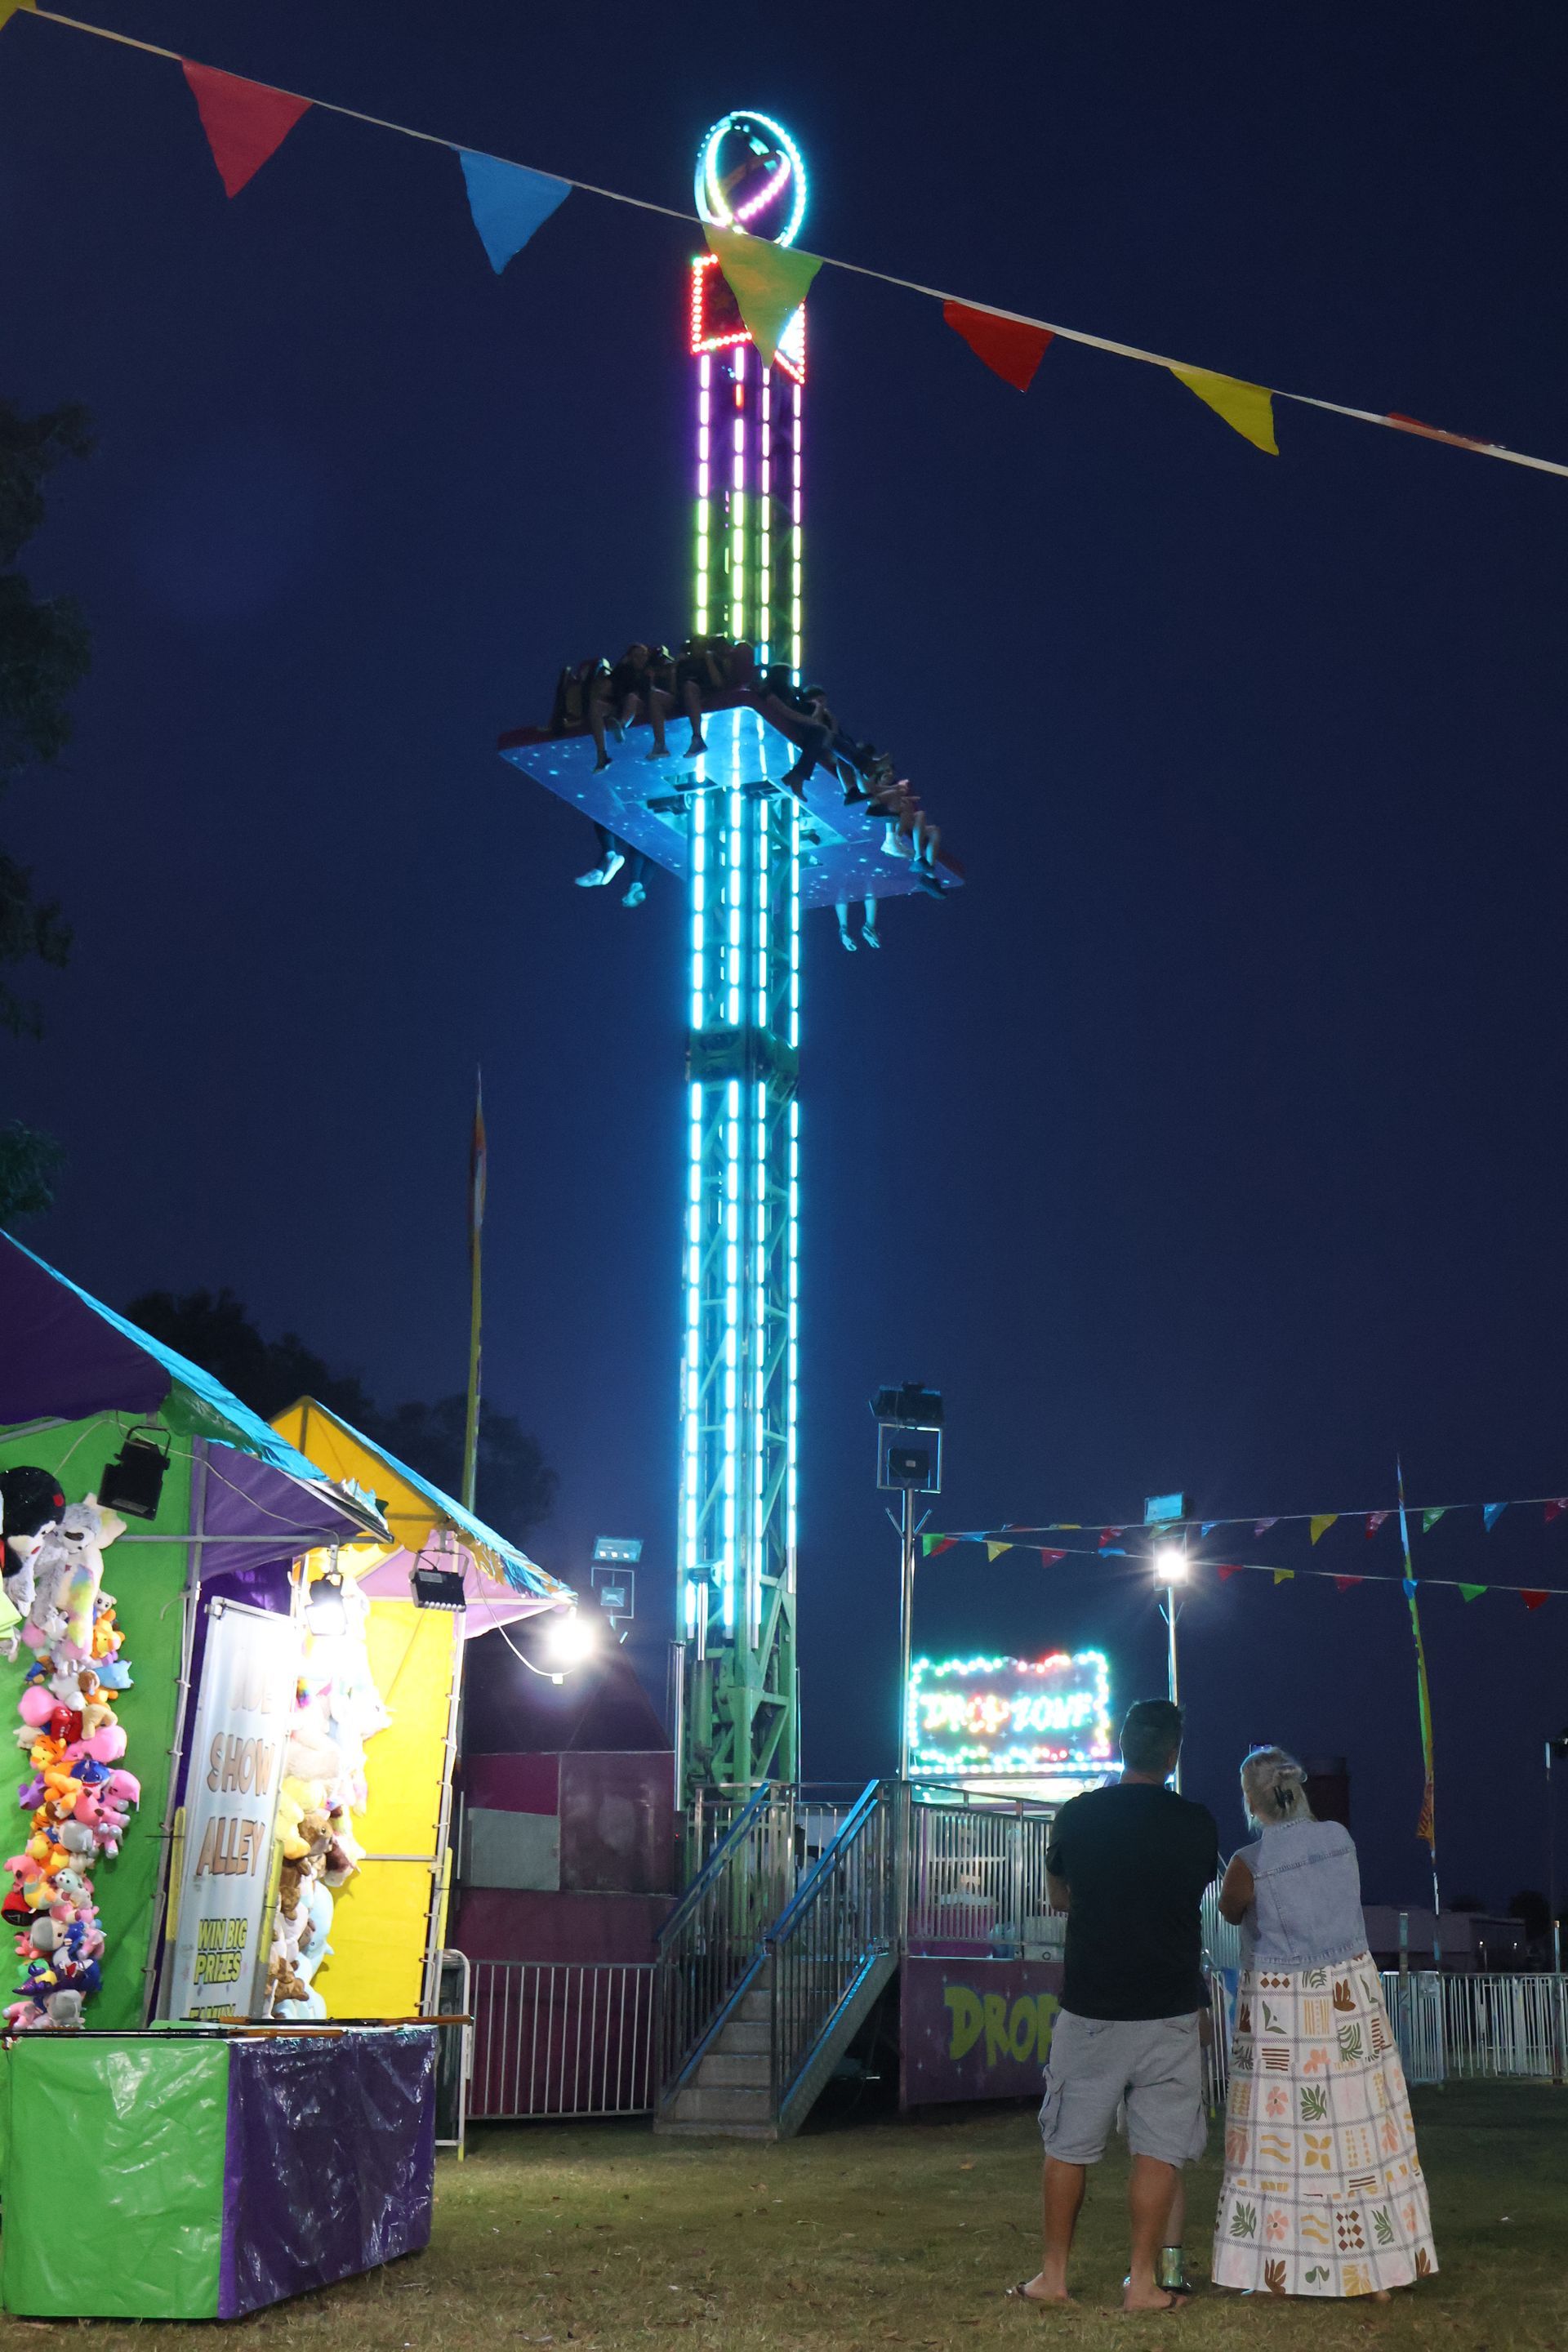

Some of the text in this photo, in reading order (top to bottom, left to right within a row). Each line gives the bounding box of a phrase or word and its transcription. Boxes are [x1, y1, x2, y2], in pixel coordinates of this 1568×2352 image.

[207, 1731, 276, 1797] SHOW
[196, 1816, 266, 1877] ALLEY
[198, 1918, 247, 1951] WIN BIG
[194, 1950, 243, 1985] PRIZES
